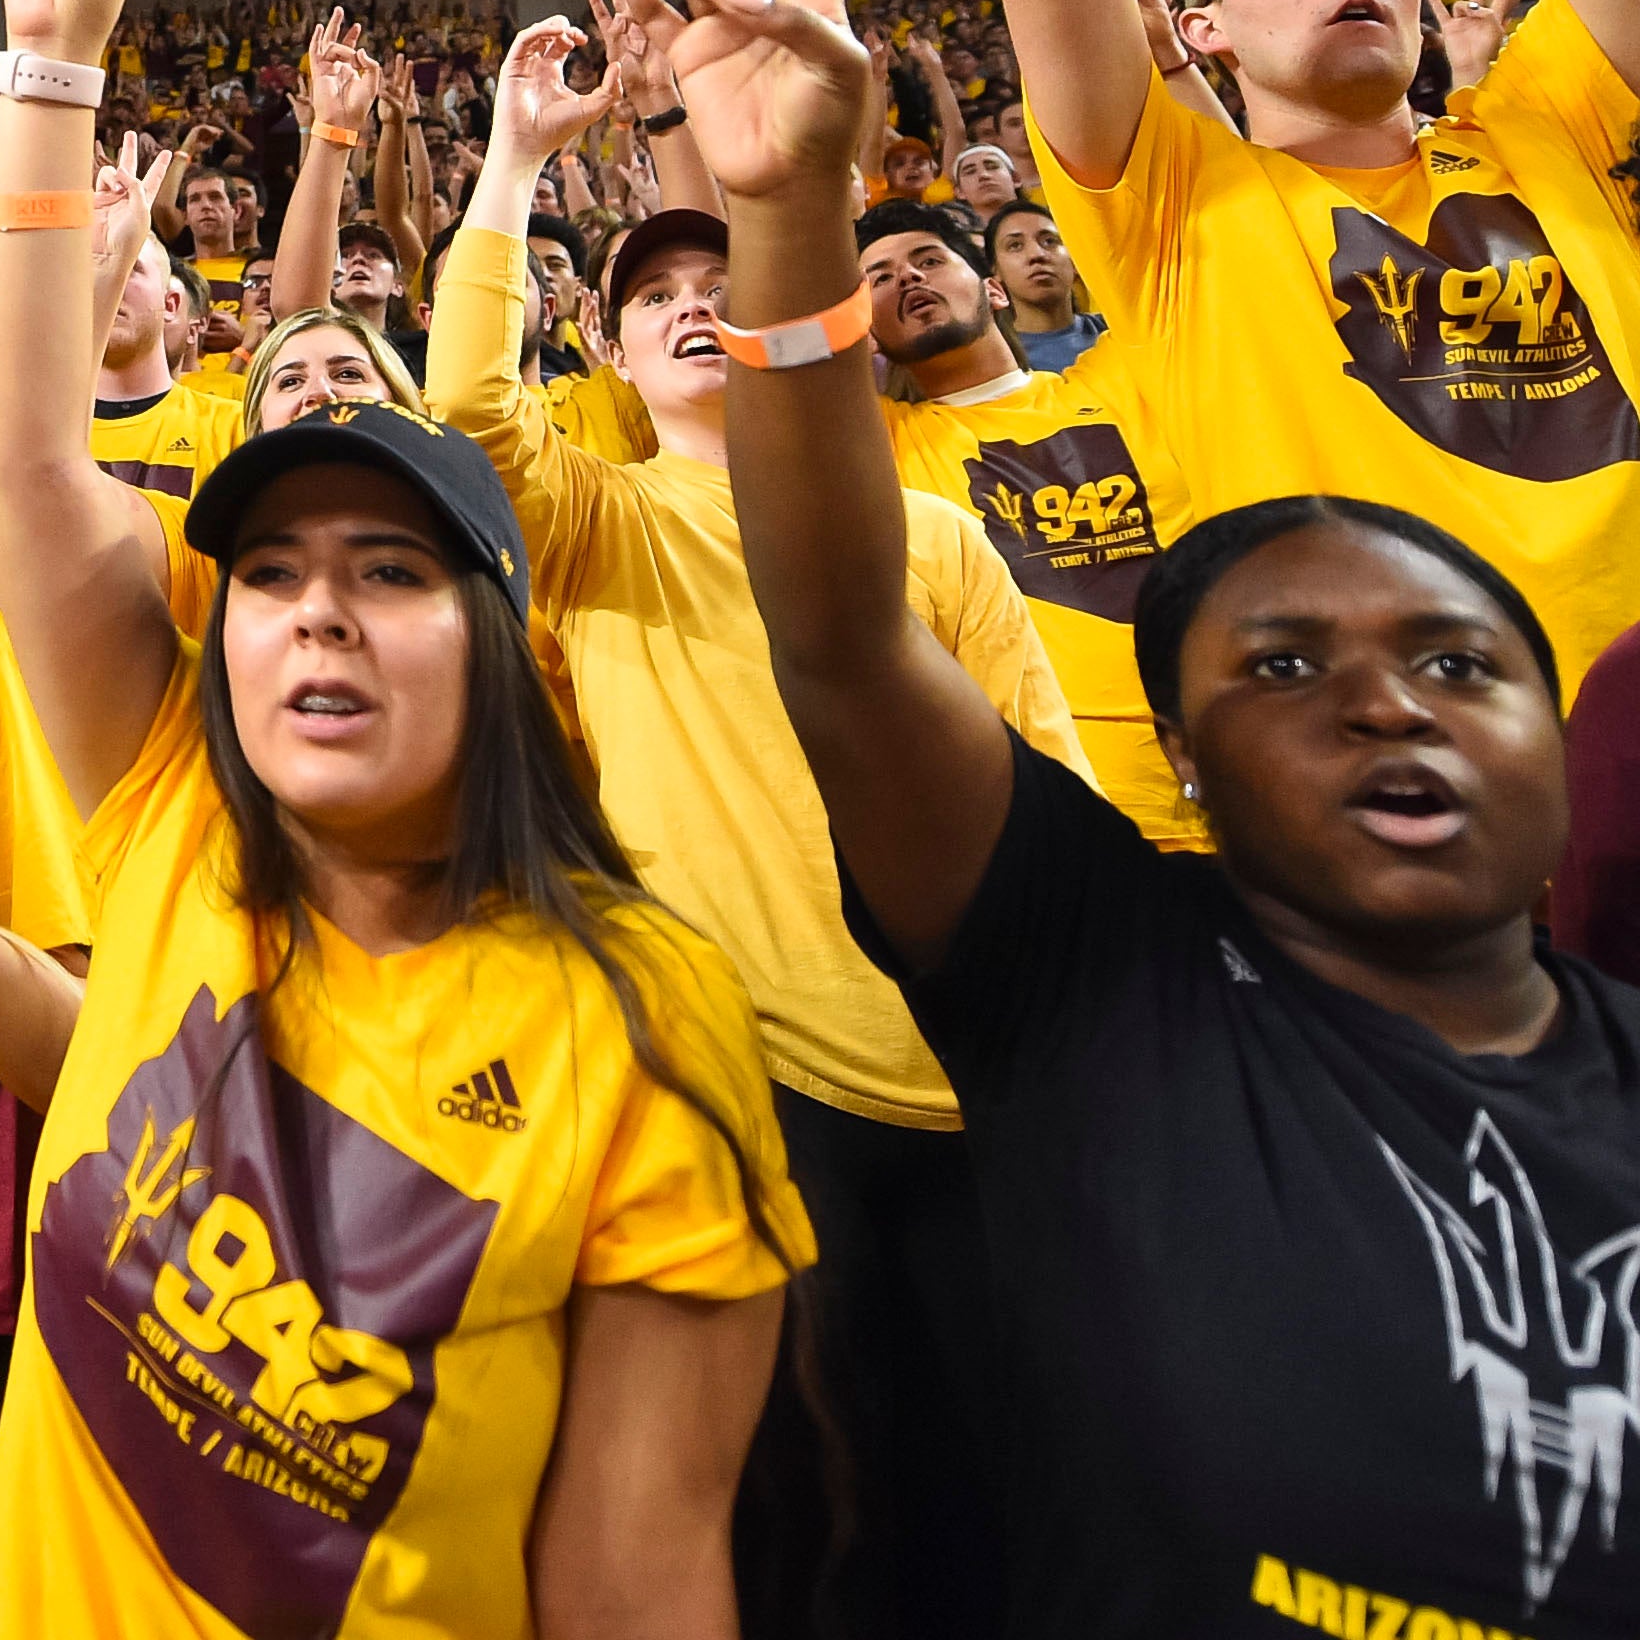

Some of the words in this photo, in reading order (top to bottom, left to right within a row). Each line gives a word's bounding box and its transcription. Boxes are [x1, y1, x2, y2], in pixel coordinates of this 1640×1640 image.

[1438, 255, 1563, 346] 942
[1514, 339, 1588, 364] ATHLETICS
[1445, 383, 1507, 401] TEMPE
[1524, 364, 1602, 401] ARIZONA
[1032, 474, 1137, 539] 942
[1049, 552, 1093, 569] TEMPE
[136, 1312, 180, 1363] SUN
[153, 1193, 414, 1429] 942
[1251, 1553, 1538, 1640] ARIZO
